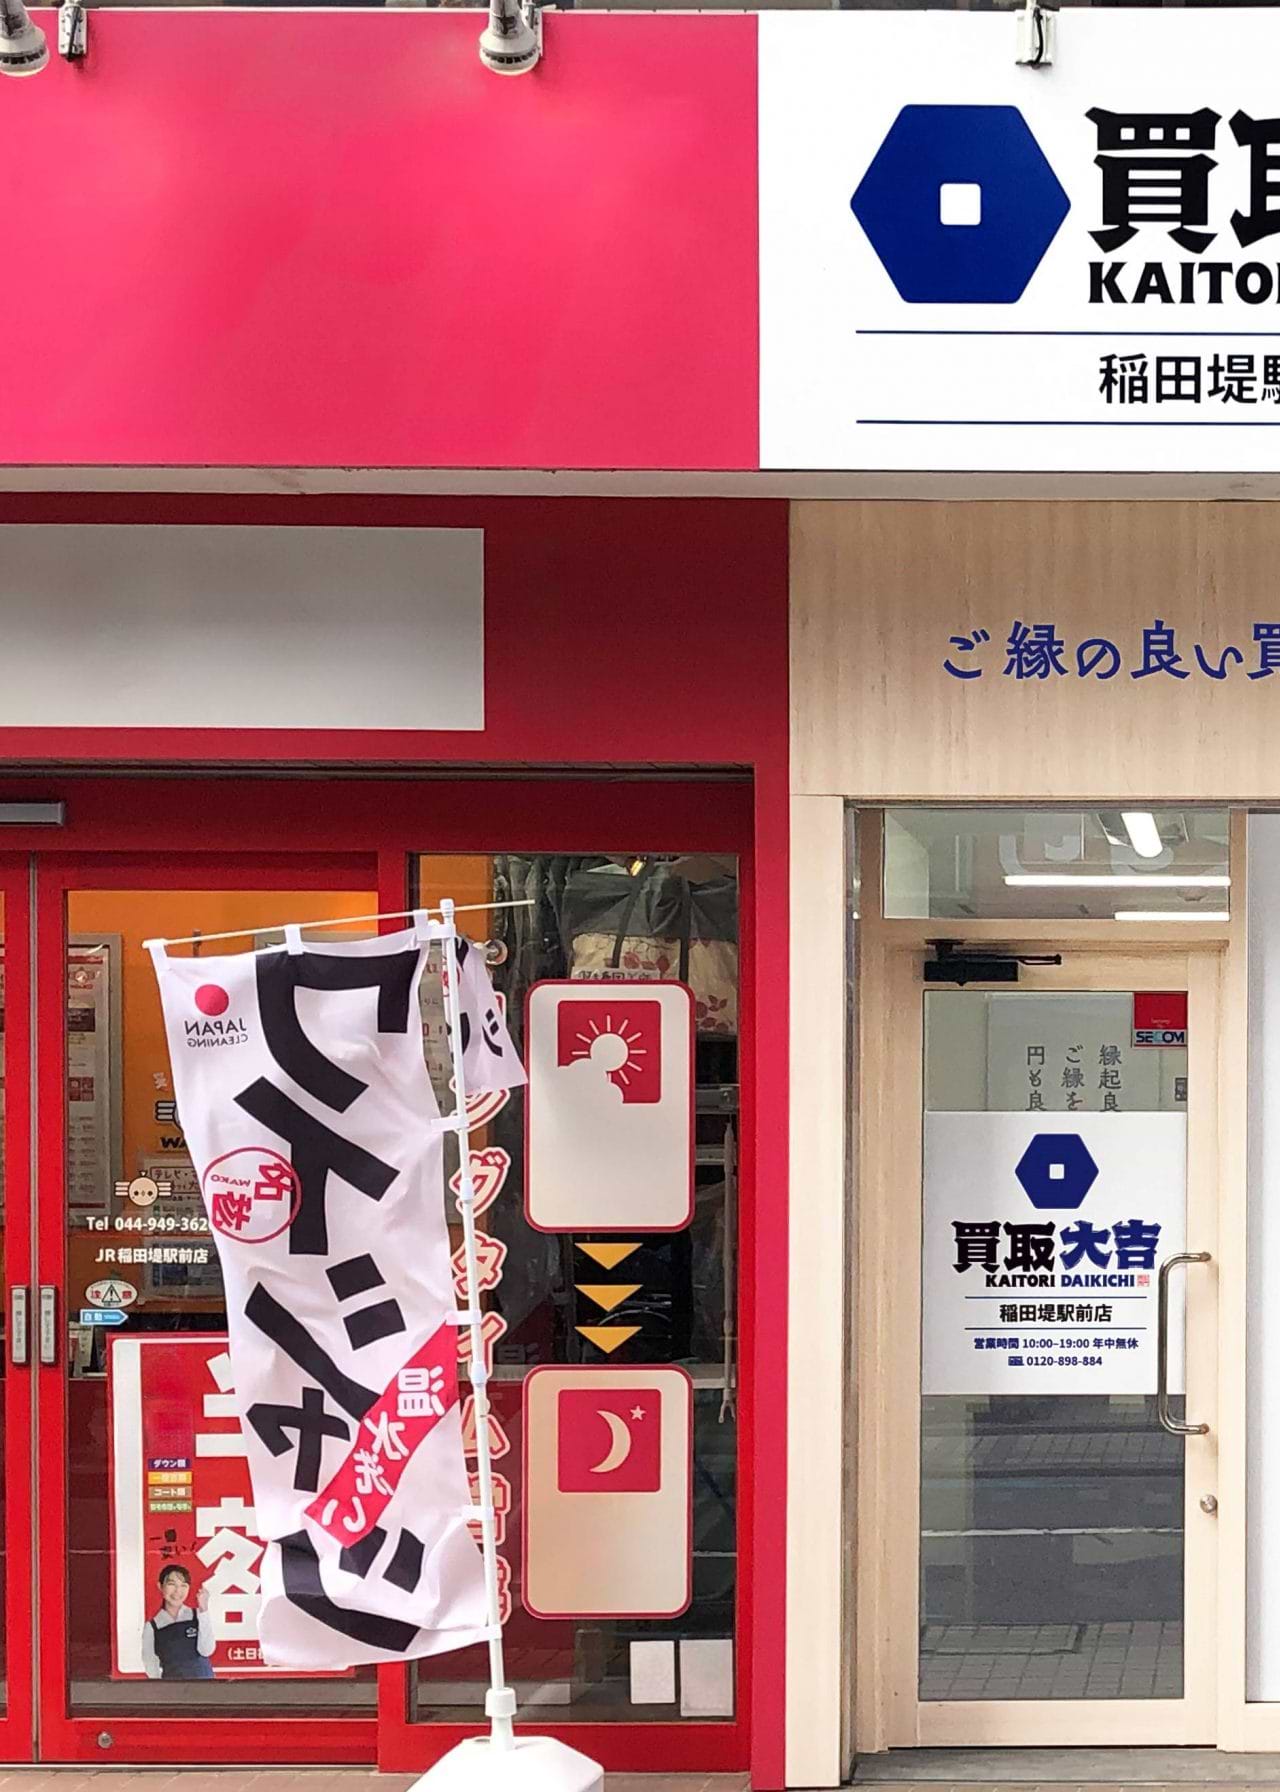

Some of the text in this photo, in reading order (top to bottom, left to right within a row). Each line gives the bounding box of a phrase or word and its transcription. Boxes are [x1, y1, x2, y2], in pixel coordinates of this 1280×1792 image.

[1136, 1031, 1185, 1043] SECOM
[86, 1217, 209, 1231] Tel 044-949-362
[951, 1219, 1162, 1273] 買取大吉
[986, 1274, 1055, 1288] KAITORI
[1060, 1274, 1135, 1288] DAIKICHI
[999, 1303, 1113, 1323] 稲田堤駅前店
[974, 1337, 1020, 1350] 営業時間
[1092, 1337, 1139, 1350] 年中無休
[1026, 1355, 1103, 1367] 0120-898-884
